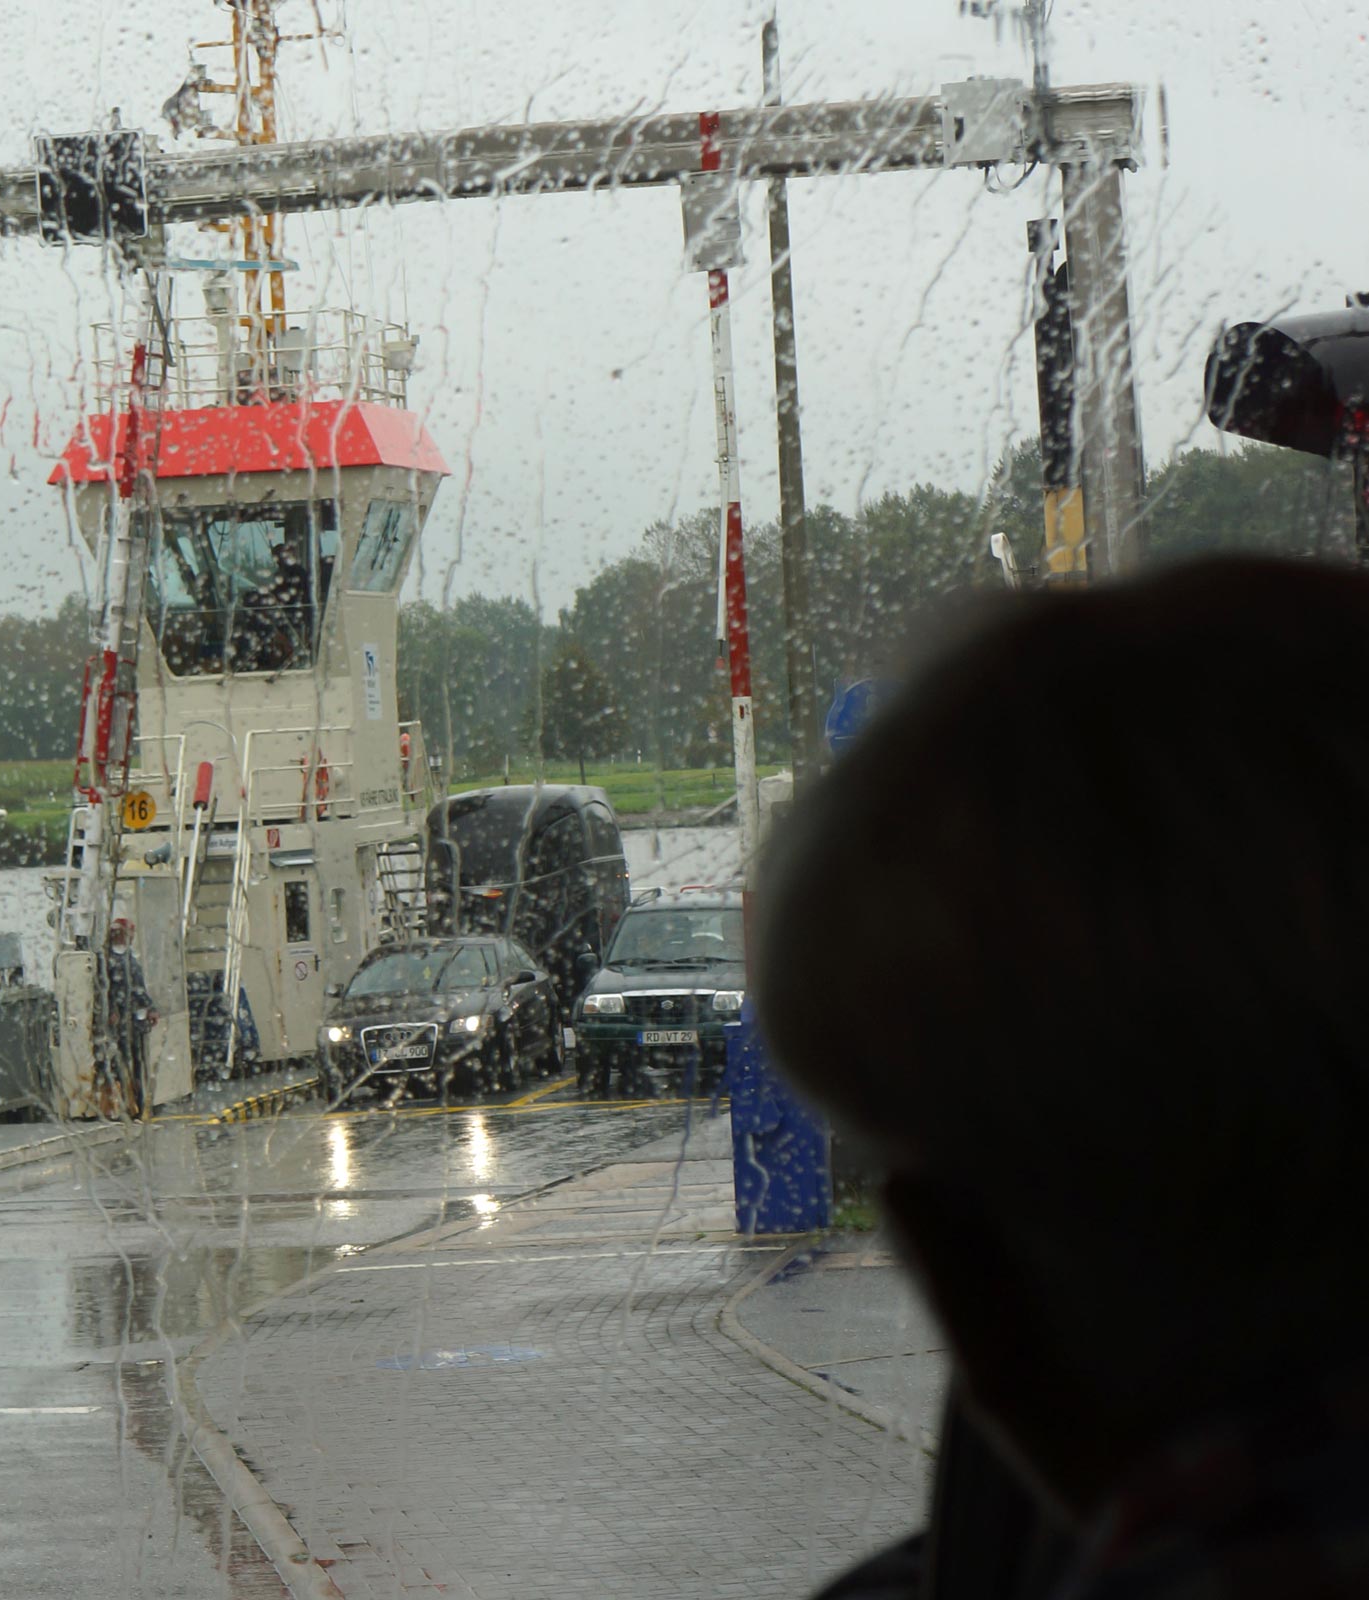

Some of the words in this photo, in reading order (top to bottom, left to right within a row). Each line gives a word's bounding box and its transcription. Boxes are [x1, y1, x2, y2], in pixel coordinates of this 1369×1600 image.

[128, 799, 148, 821] 16
[646, 1032, 660, 1042] RD
[665, 1032, 679, 1042] VT
[409, 1046, 427, 1057] 900
